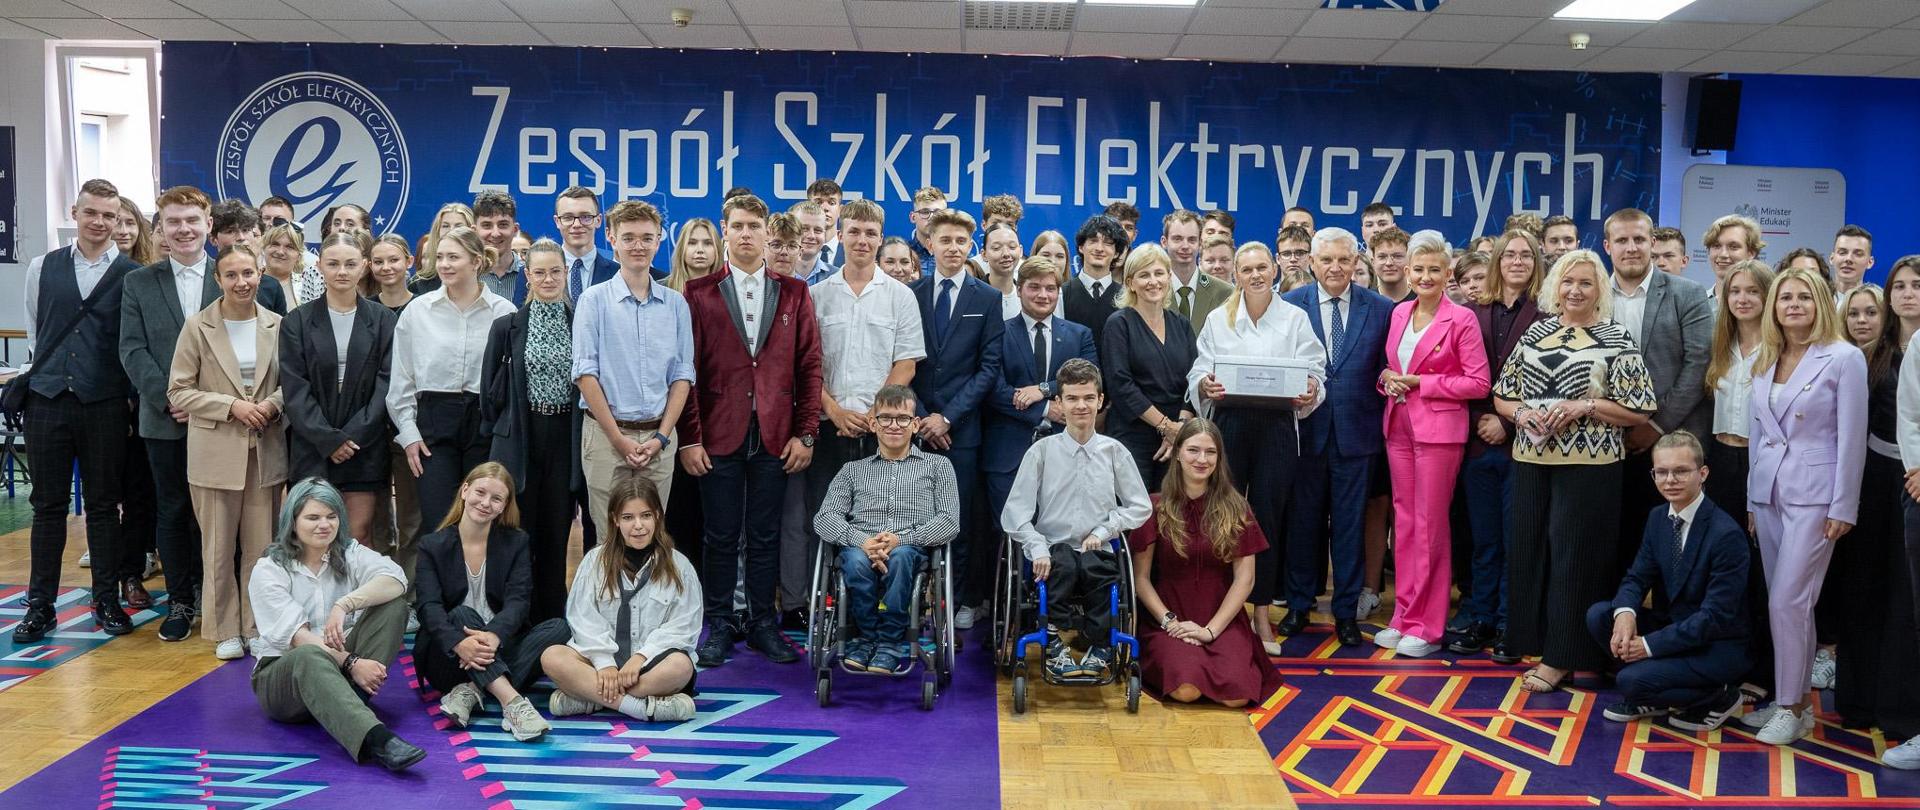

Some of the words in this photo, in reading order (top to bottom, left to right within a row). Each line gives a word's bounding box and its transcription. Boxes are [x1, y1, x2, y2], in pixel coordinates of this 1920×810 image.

[226, 120, 255, 180] ZESPÓŁ
[251, 85, 301, 120] SZKÓŁ
[307, 83, 399, 183] ELEKTRYCZNYCH
[469, 86, 739, 202] Zespół
[773, 91, 990, 203] Szkół
[1025, 96, 1604, 241] Elektrycznych
[1759, 217, 1791, 227] Edukacji
[1760, 207, 1792, 217] Minister
